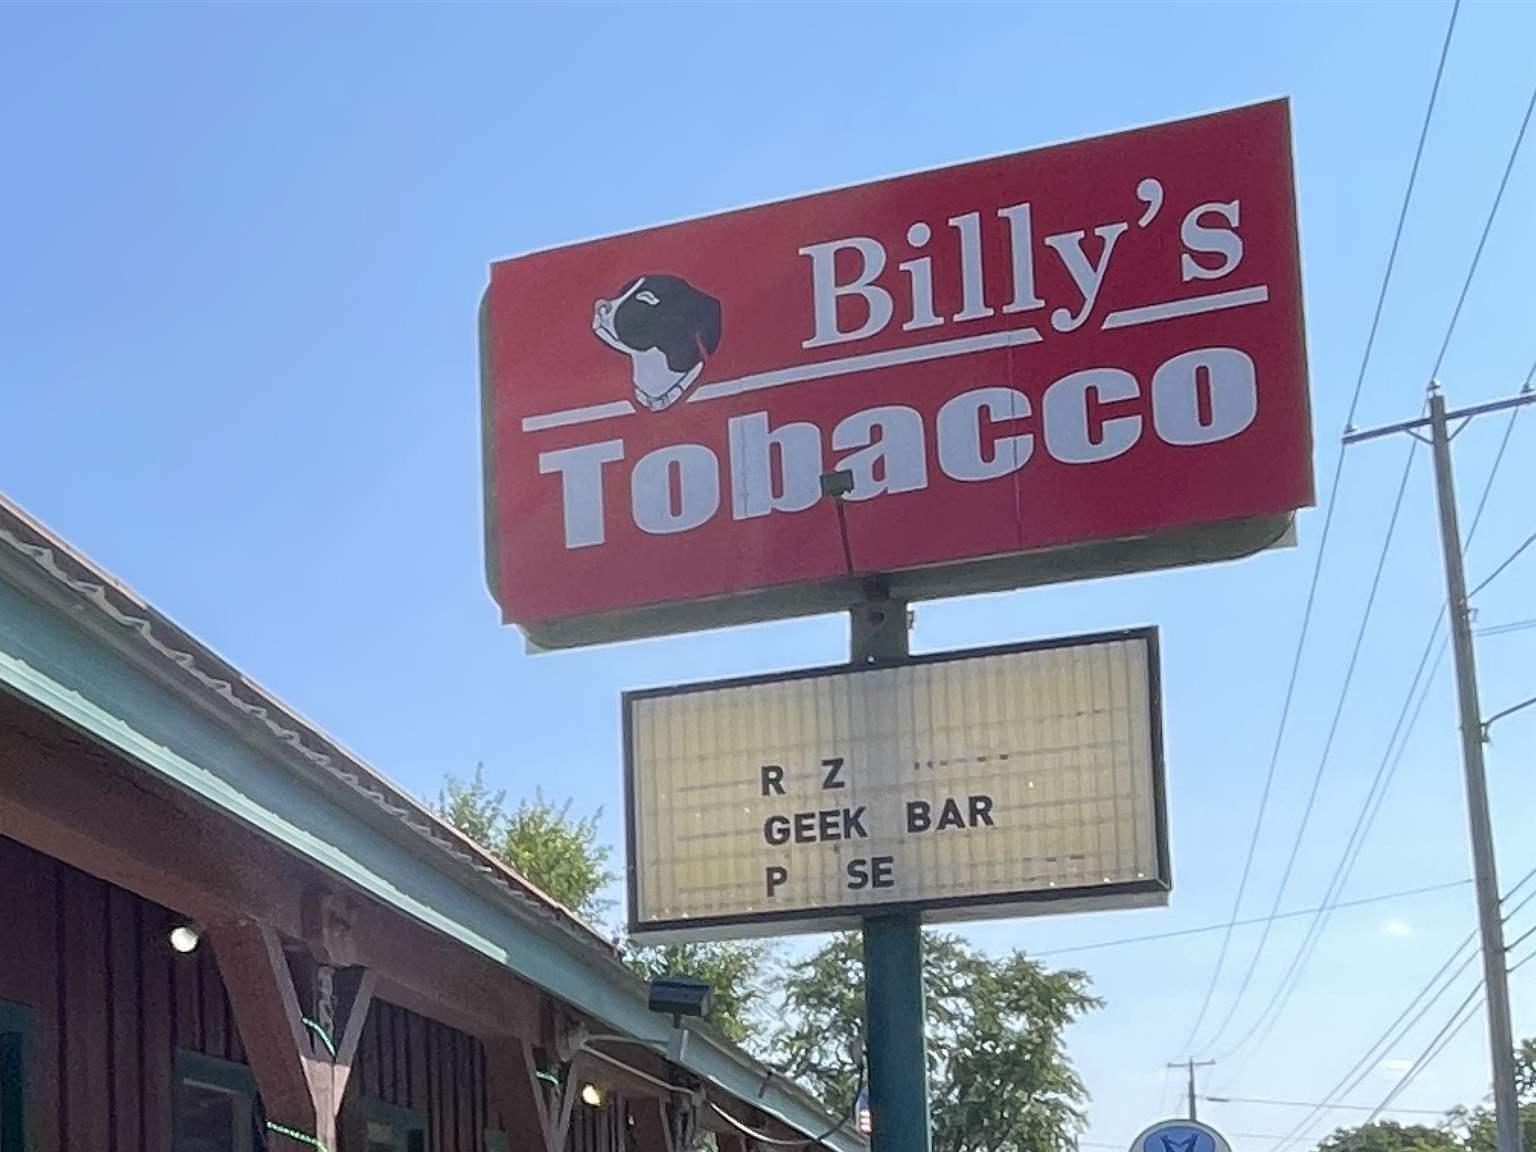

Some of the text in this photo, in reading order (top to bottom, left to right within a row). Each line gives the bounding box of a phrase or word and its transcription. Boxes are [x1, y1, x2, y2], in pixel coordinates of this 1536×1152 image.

[798, 178, 1245, 350] Billy's
[538, 347, 1258, 549] Tobacco
[761, 758, 845, 796] R Z
[764, 796, 994, 845] GEEK BAR
[766, 857, 895, 897] P SE
